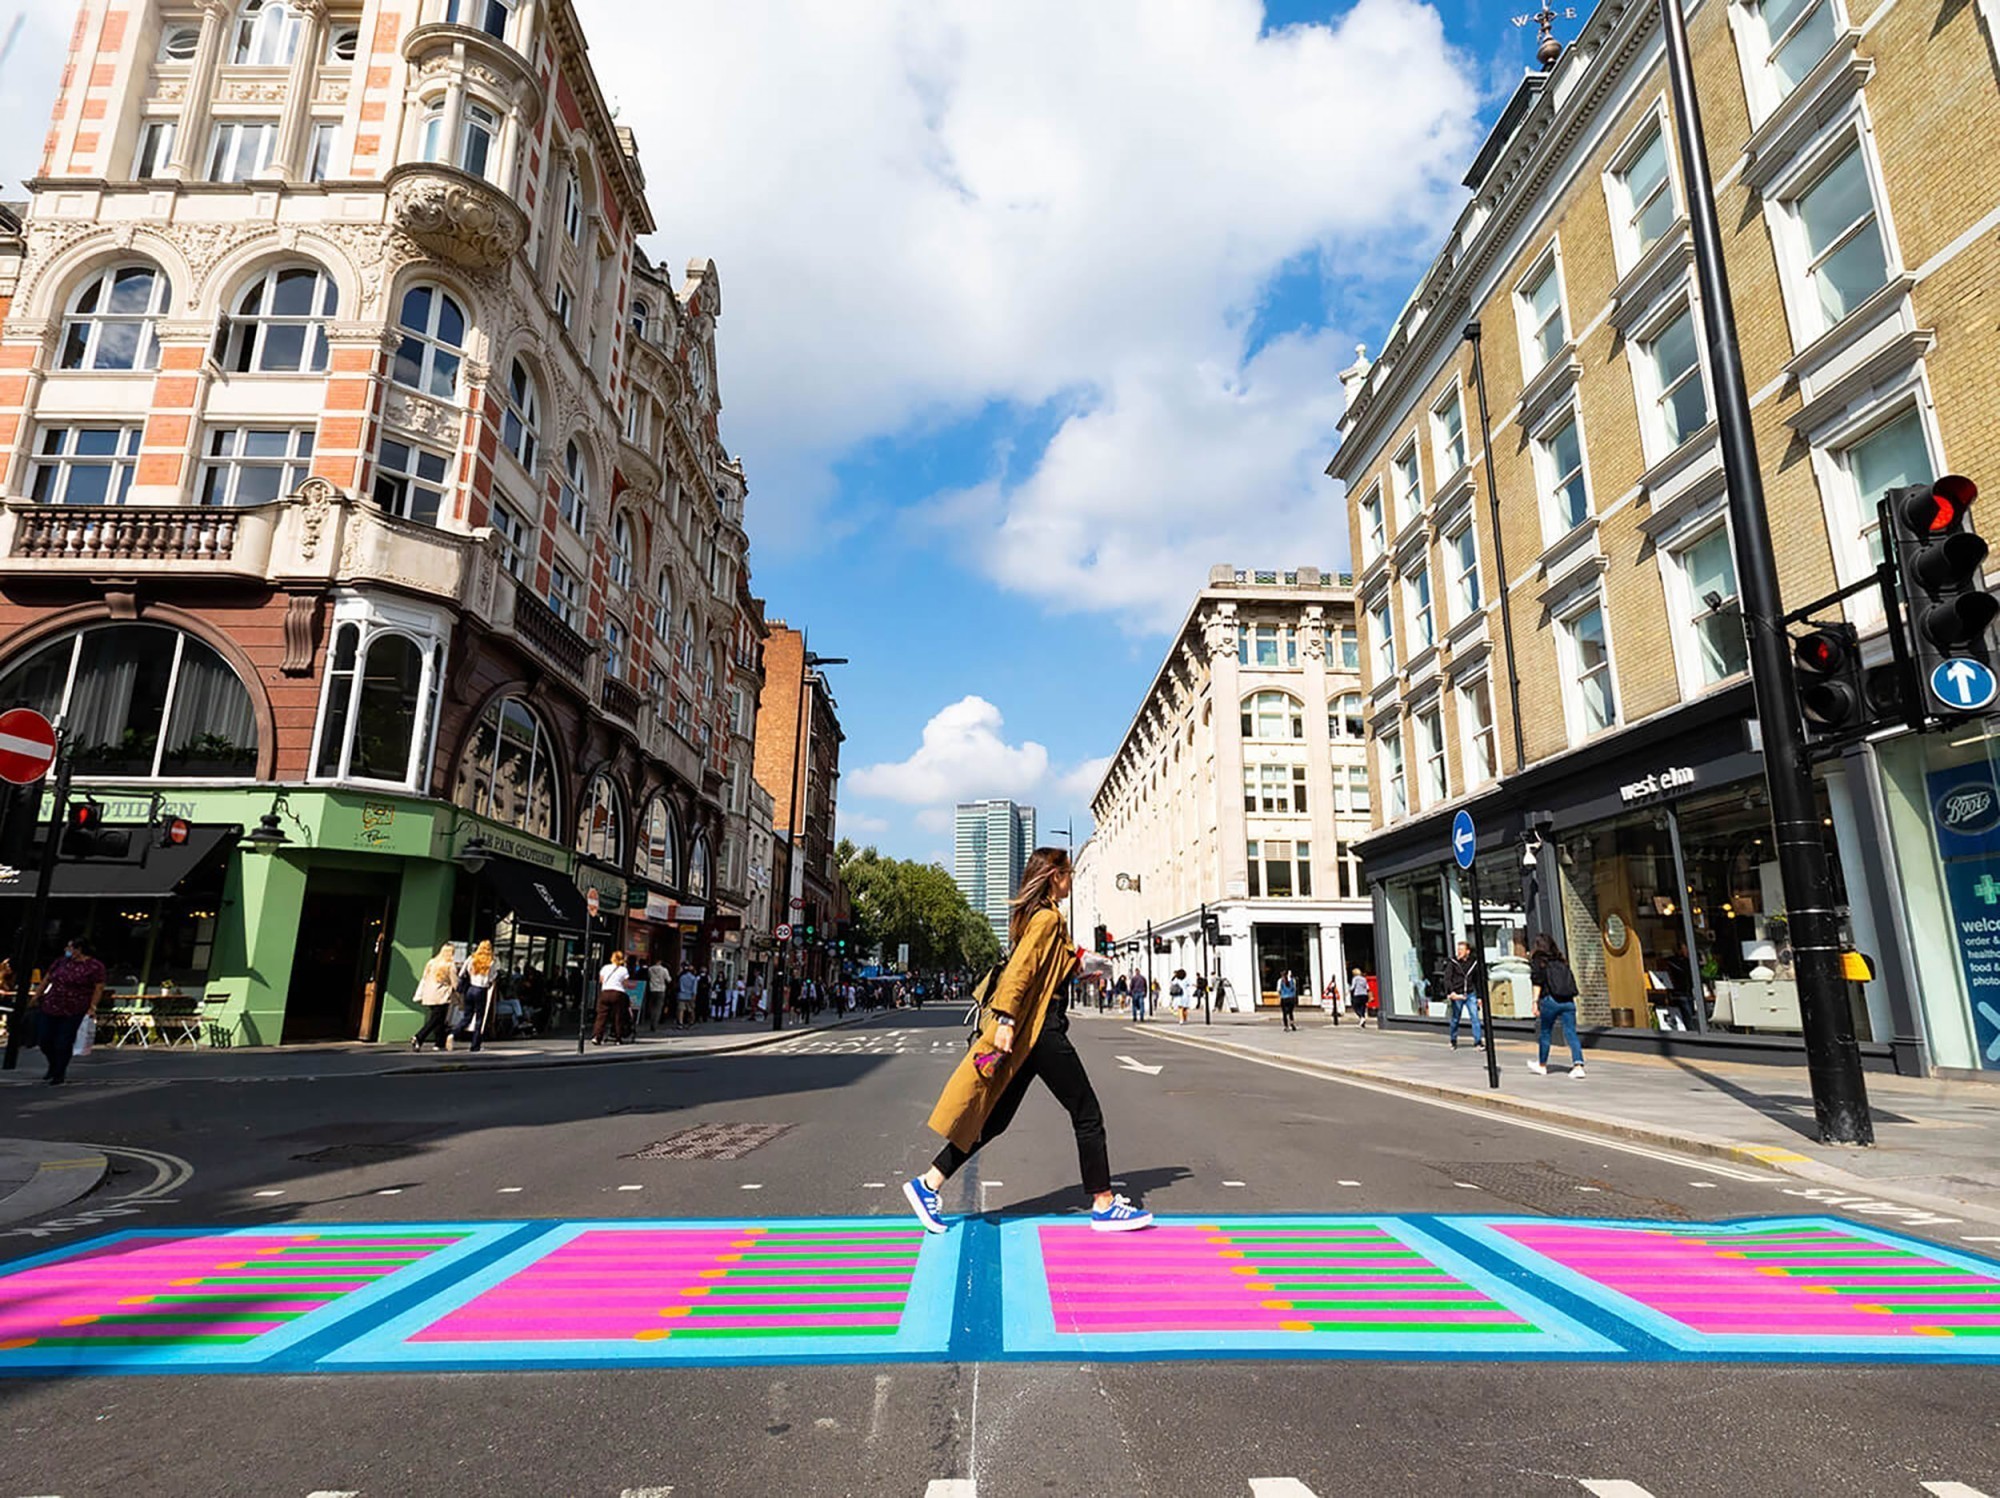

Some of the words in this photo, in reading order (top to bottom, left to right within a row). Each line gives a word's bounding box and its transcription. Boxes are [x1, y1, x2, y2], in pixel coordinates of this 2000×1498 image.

[1511, 14, 1529, 27] W
[1565, 7, 1577, 19] E
[1620, 773, 1660, 801] west
[1660, 767, 1695, 789] elm
[1945, 792, 1991, 824] Boots
[777, 927, 789, 936] 20
[1965, 936, 1991, 946] order
[1969, 962, 1992, 973] food
[0, 1199, 181, 1238] LOOK
